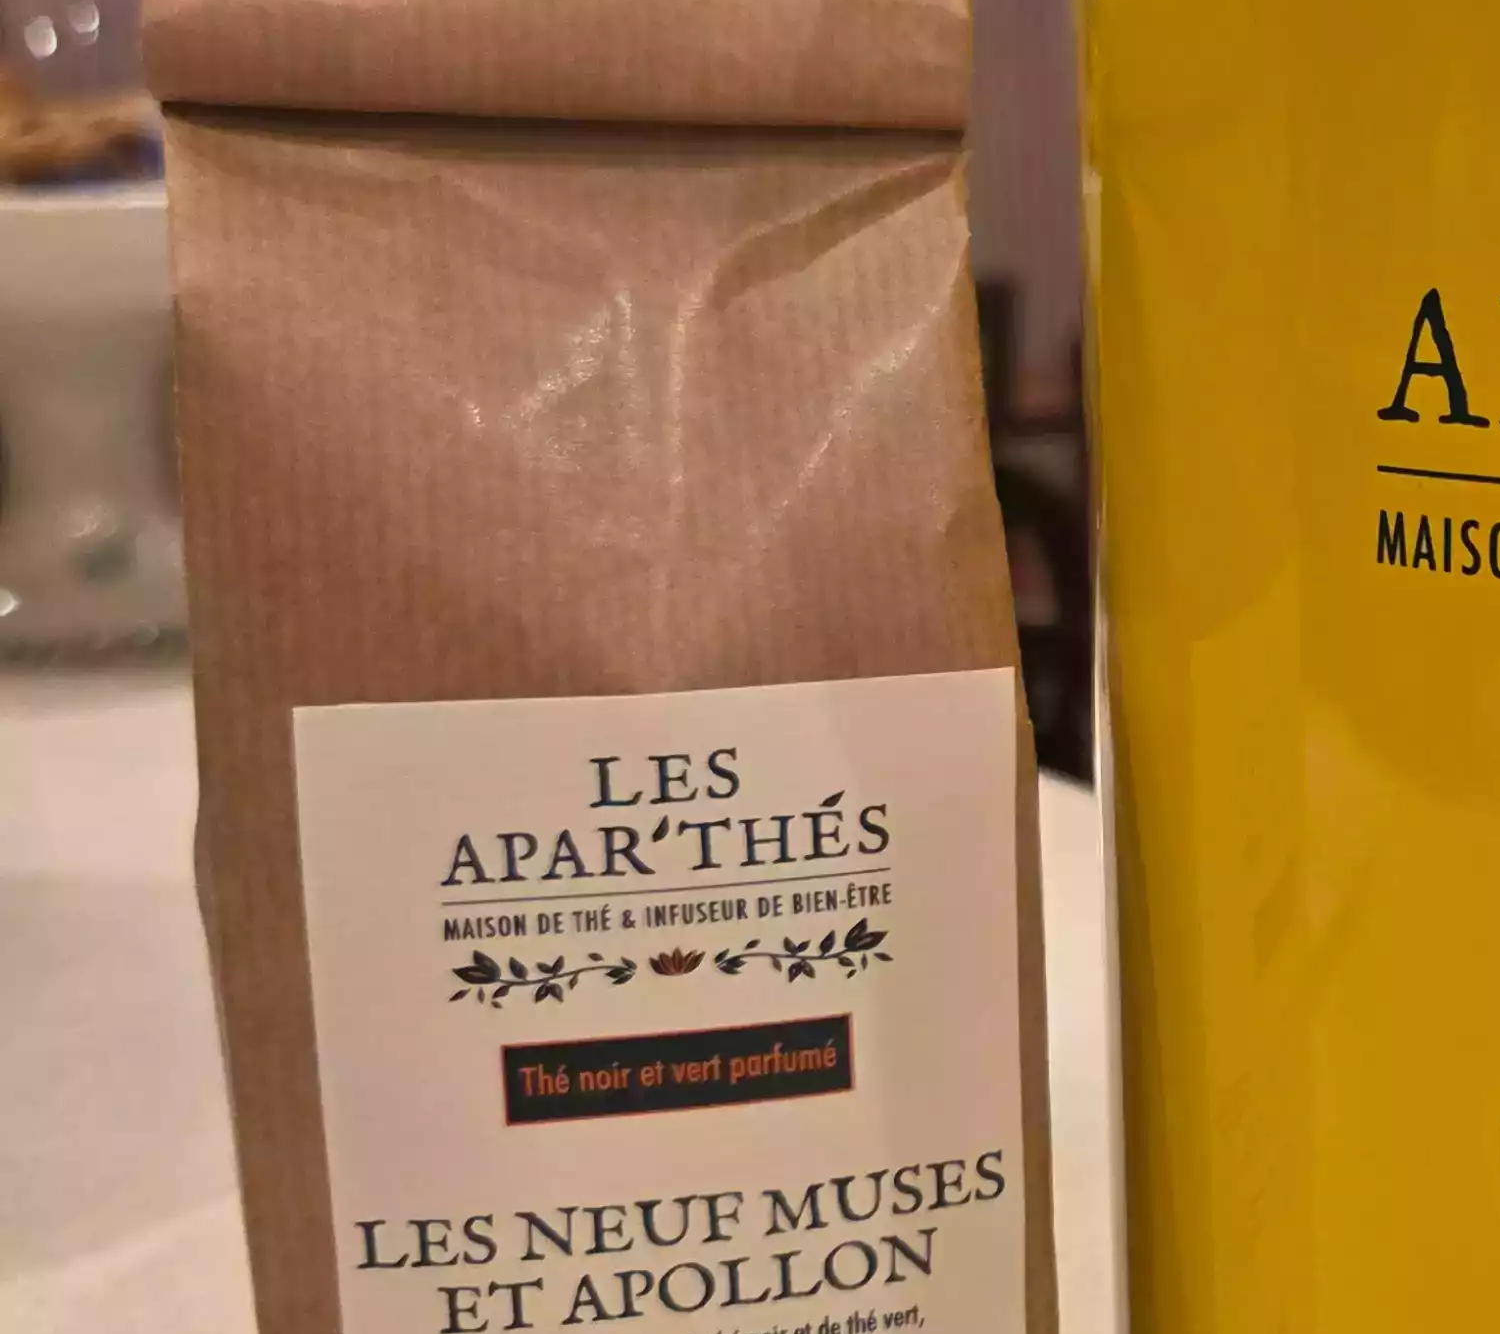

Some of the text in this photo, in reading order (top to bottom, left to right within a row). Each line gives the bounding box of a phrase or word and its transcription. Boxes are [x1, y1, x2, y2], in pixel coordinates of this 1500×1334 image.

[589, 747, 741, 808] LES
[440, 791, 891, 887] APAR'THÉS
[443, 883, 892, 941] MAISON DE THÉ & INFUSEUR DE BIEN-ÊTRE
[519, 1039, 837, 1096] Thé noir et vert parfumé
[355, 1150, 1007, 1270] LES NEUF MUSES
[438, 1228, 939, 1334] ET APOLLON
[847, 1308, 877, 1334] thé
[883, 1305, 925, 1328] vert,
